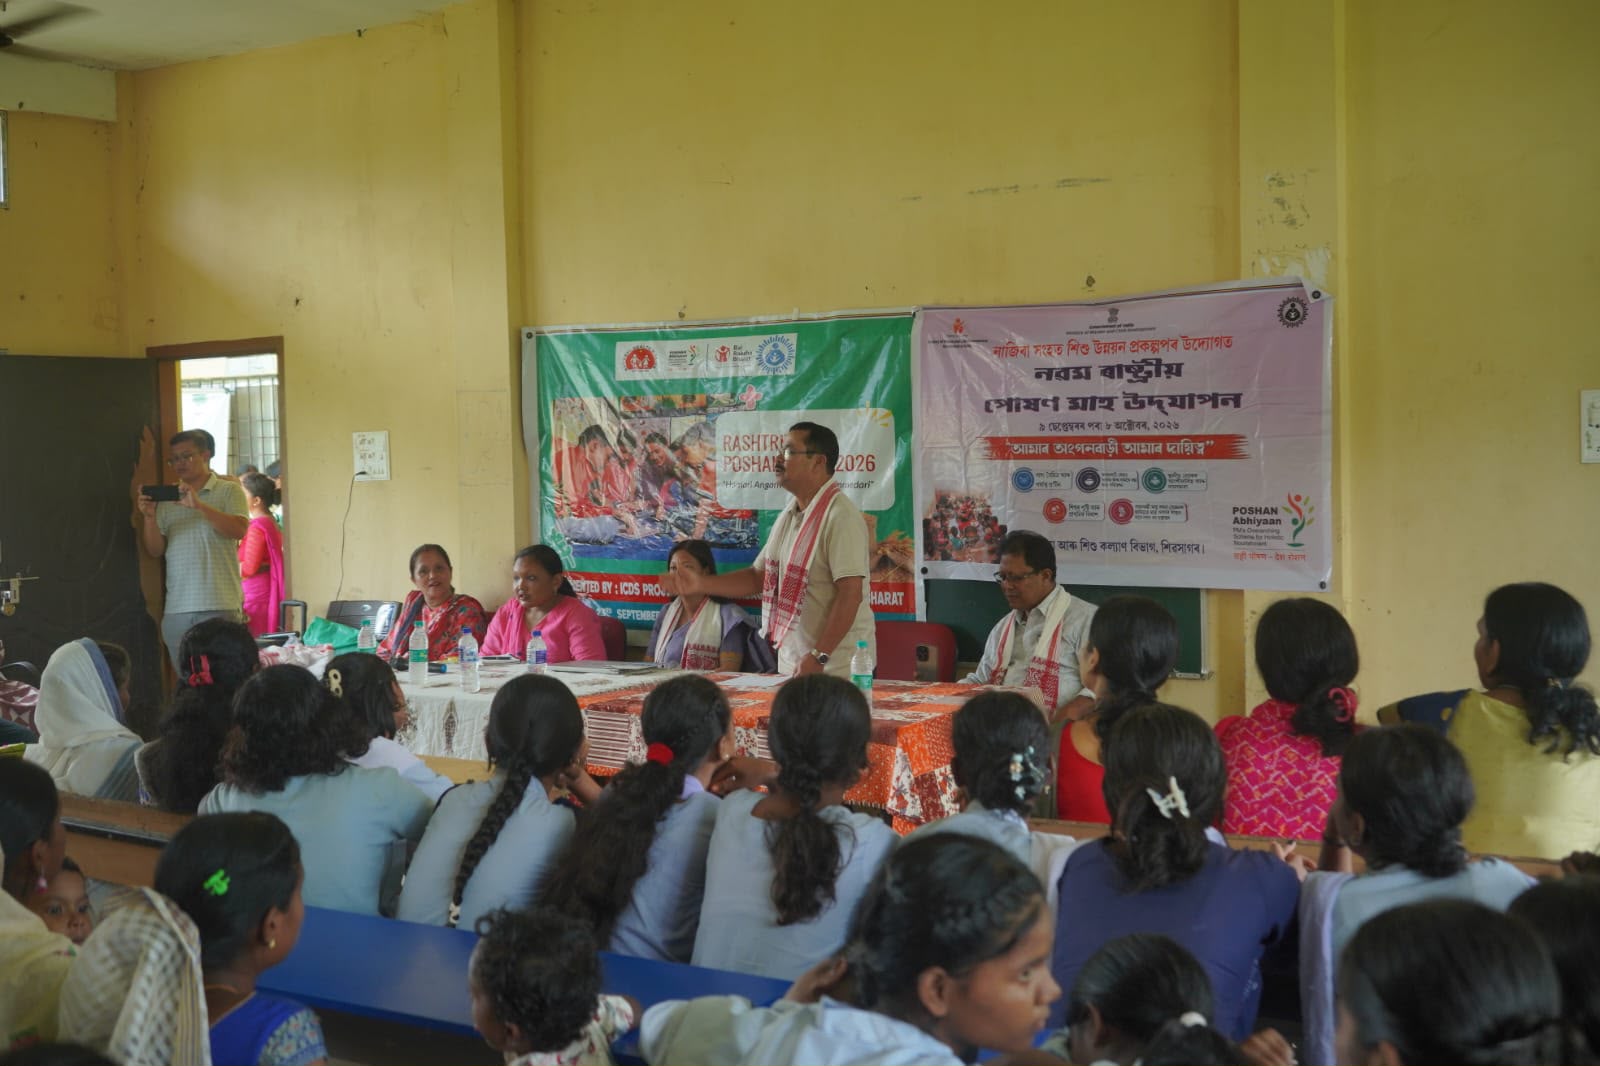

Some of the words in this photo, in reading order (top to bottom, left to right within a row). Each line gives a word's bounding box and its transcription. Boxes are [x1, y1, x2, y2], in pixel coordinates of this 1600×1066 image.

[1067, 338, 1090, 357] শিশু
[1092, 340, 1126, 355] উন্নয়ন
[984, 396, 1060, 413] পোষণ
[1066, 396, 1119, 411] মাহ
[1154, 421, 1179, 430] ২০২৬
[723, 434, 784, 451] RASHTRI
[835, 454, 876, 472] 2026
[1232, 507, 1278, 515] POSHAN
[1232, 516, 1282, 527] Abhiyaan
[1080, 538, 1097, 551] শিশু
[1100, 541, 1127, 552] কল্যাণ
[602, 580, 612, 594] BY
[620, 582, 641, 595] ICDS
[869, 591, 904, 606] HARAT
